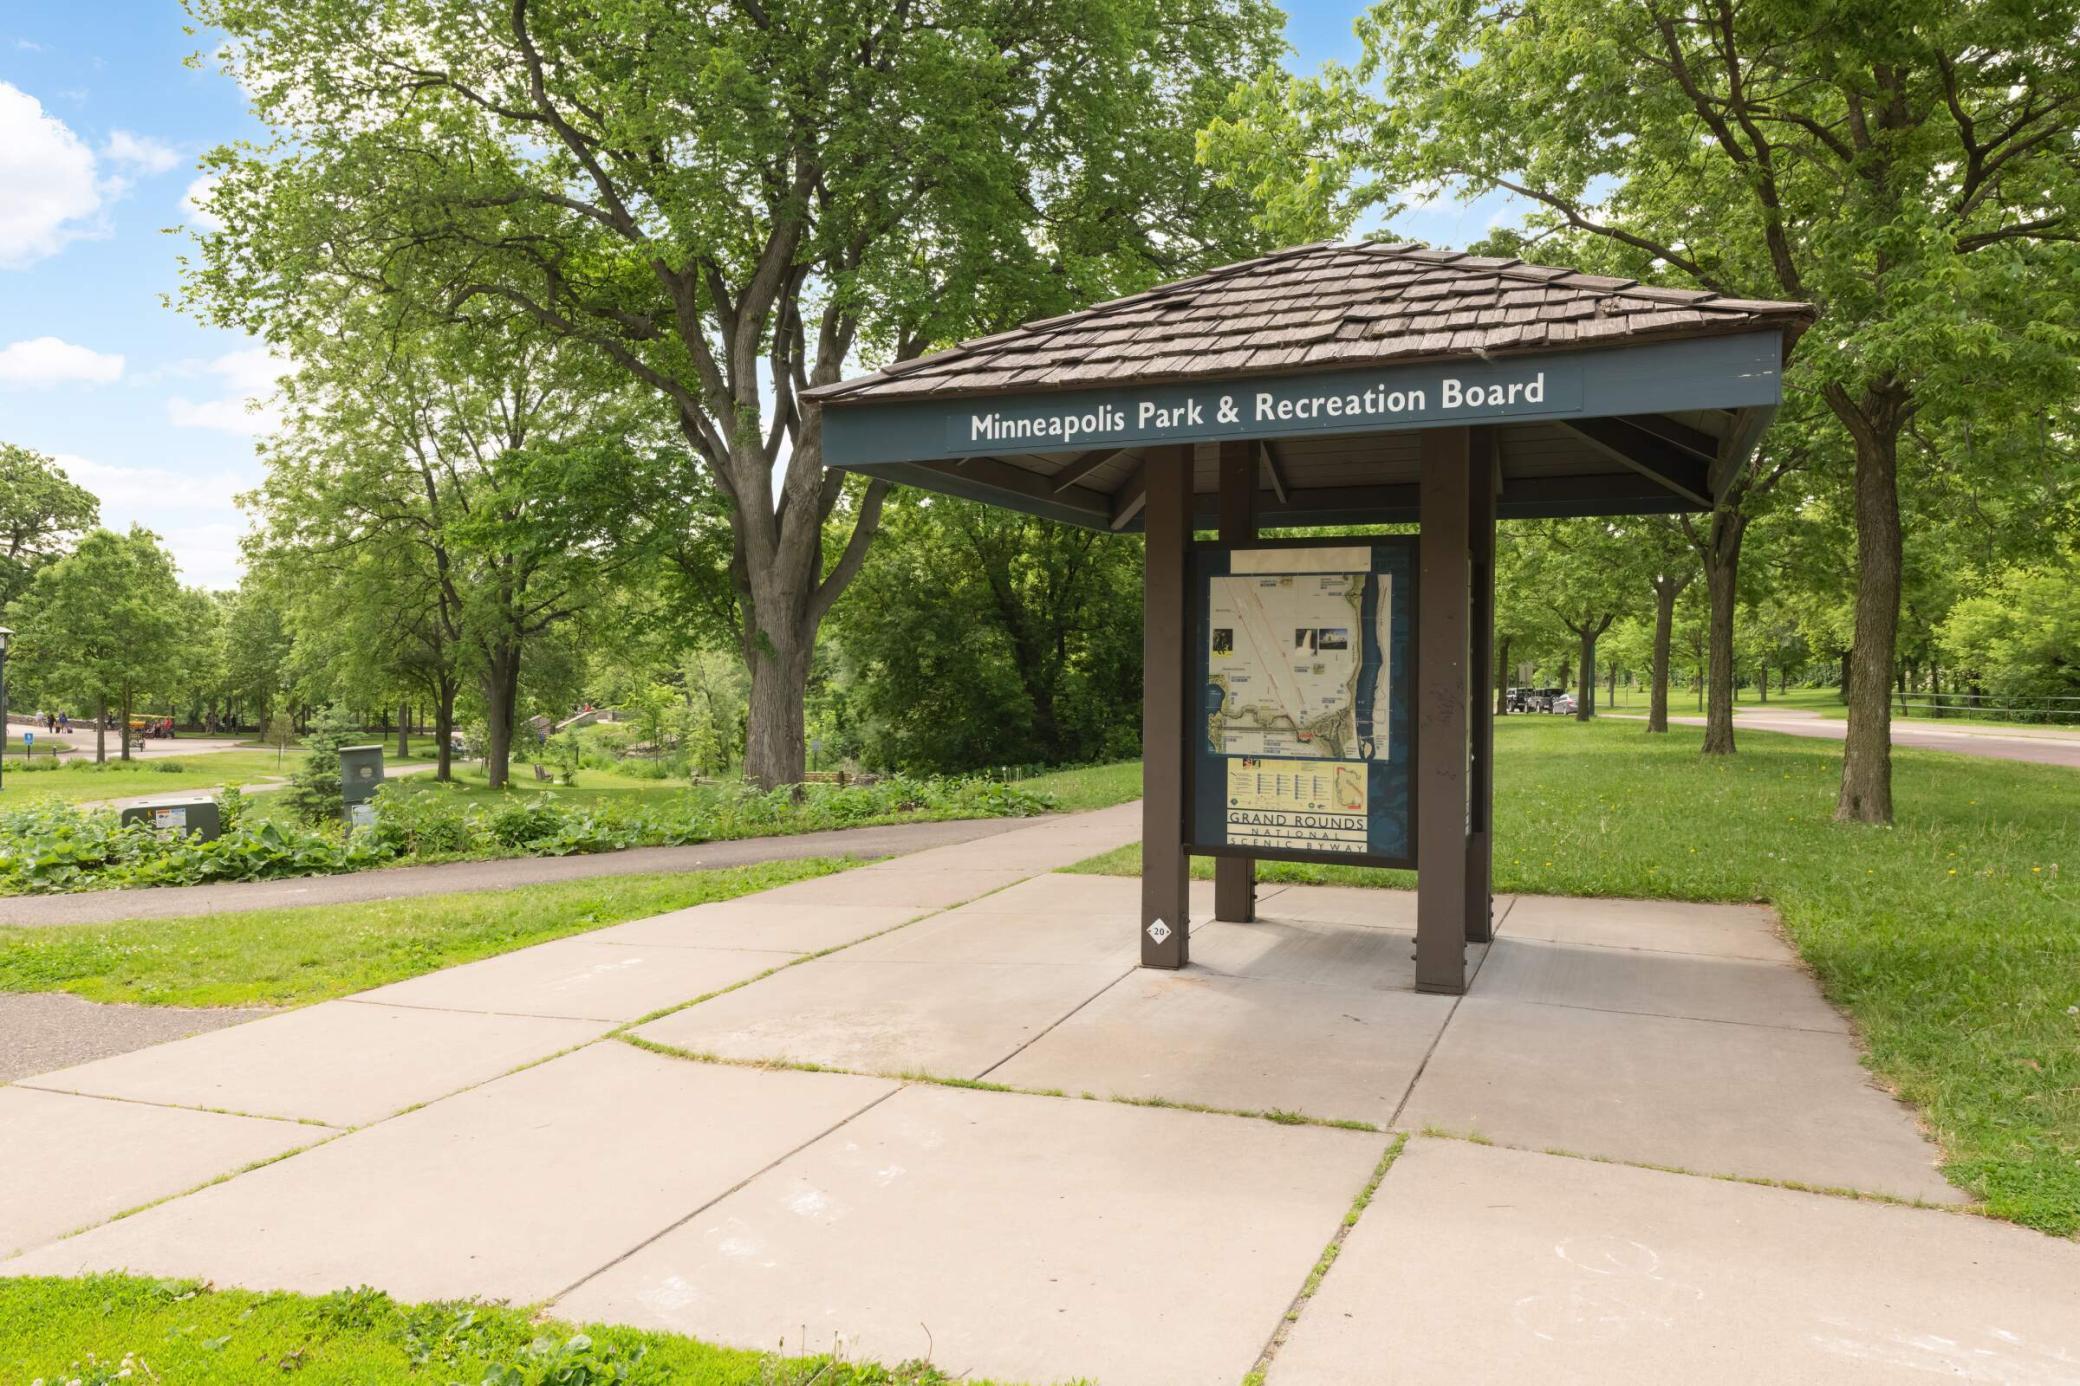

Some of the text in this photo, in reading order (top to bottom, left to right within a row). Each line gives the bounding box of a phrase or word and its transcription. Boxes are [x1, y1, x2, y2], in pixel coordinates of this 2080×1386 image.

[971, 372, 1545, 442] Minneapolis Park & Recreation Board
[1230, 812, 1364, 831] GRAND ROUNDS
[1251, 828, 1340, 841] NATIONAL
[1230, 837, 1364, 854] SCENIC BYWAY
[1154, 927, 1165, 936] 20
